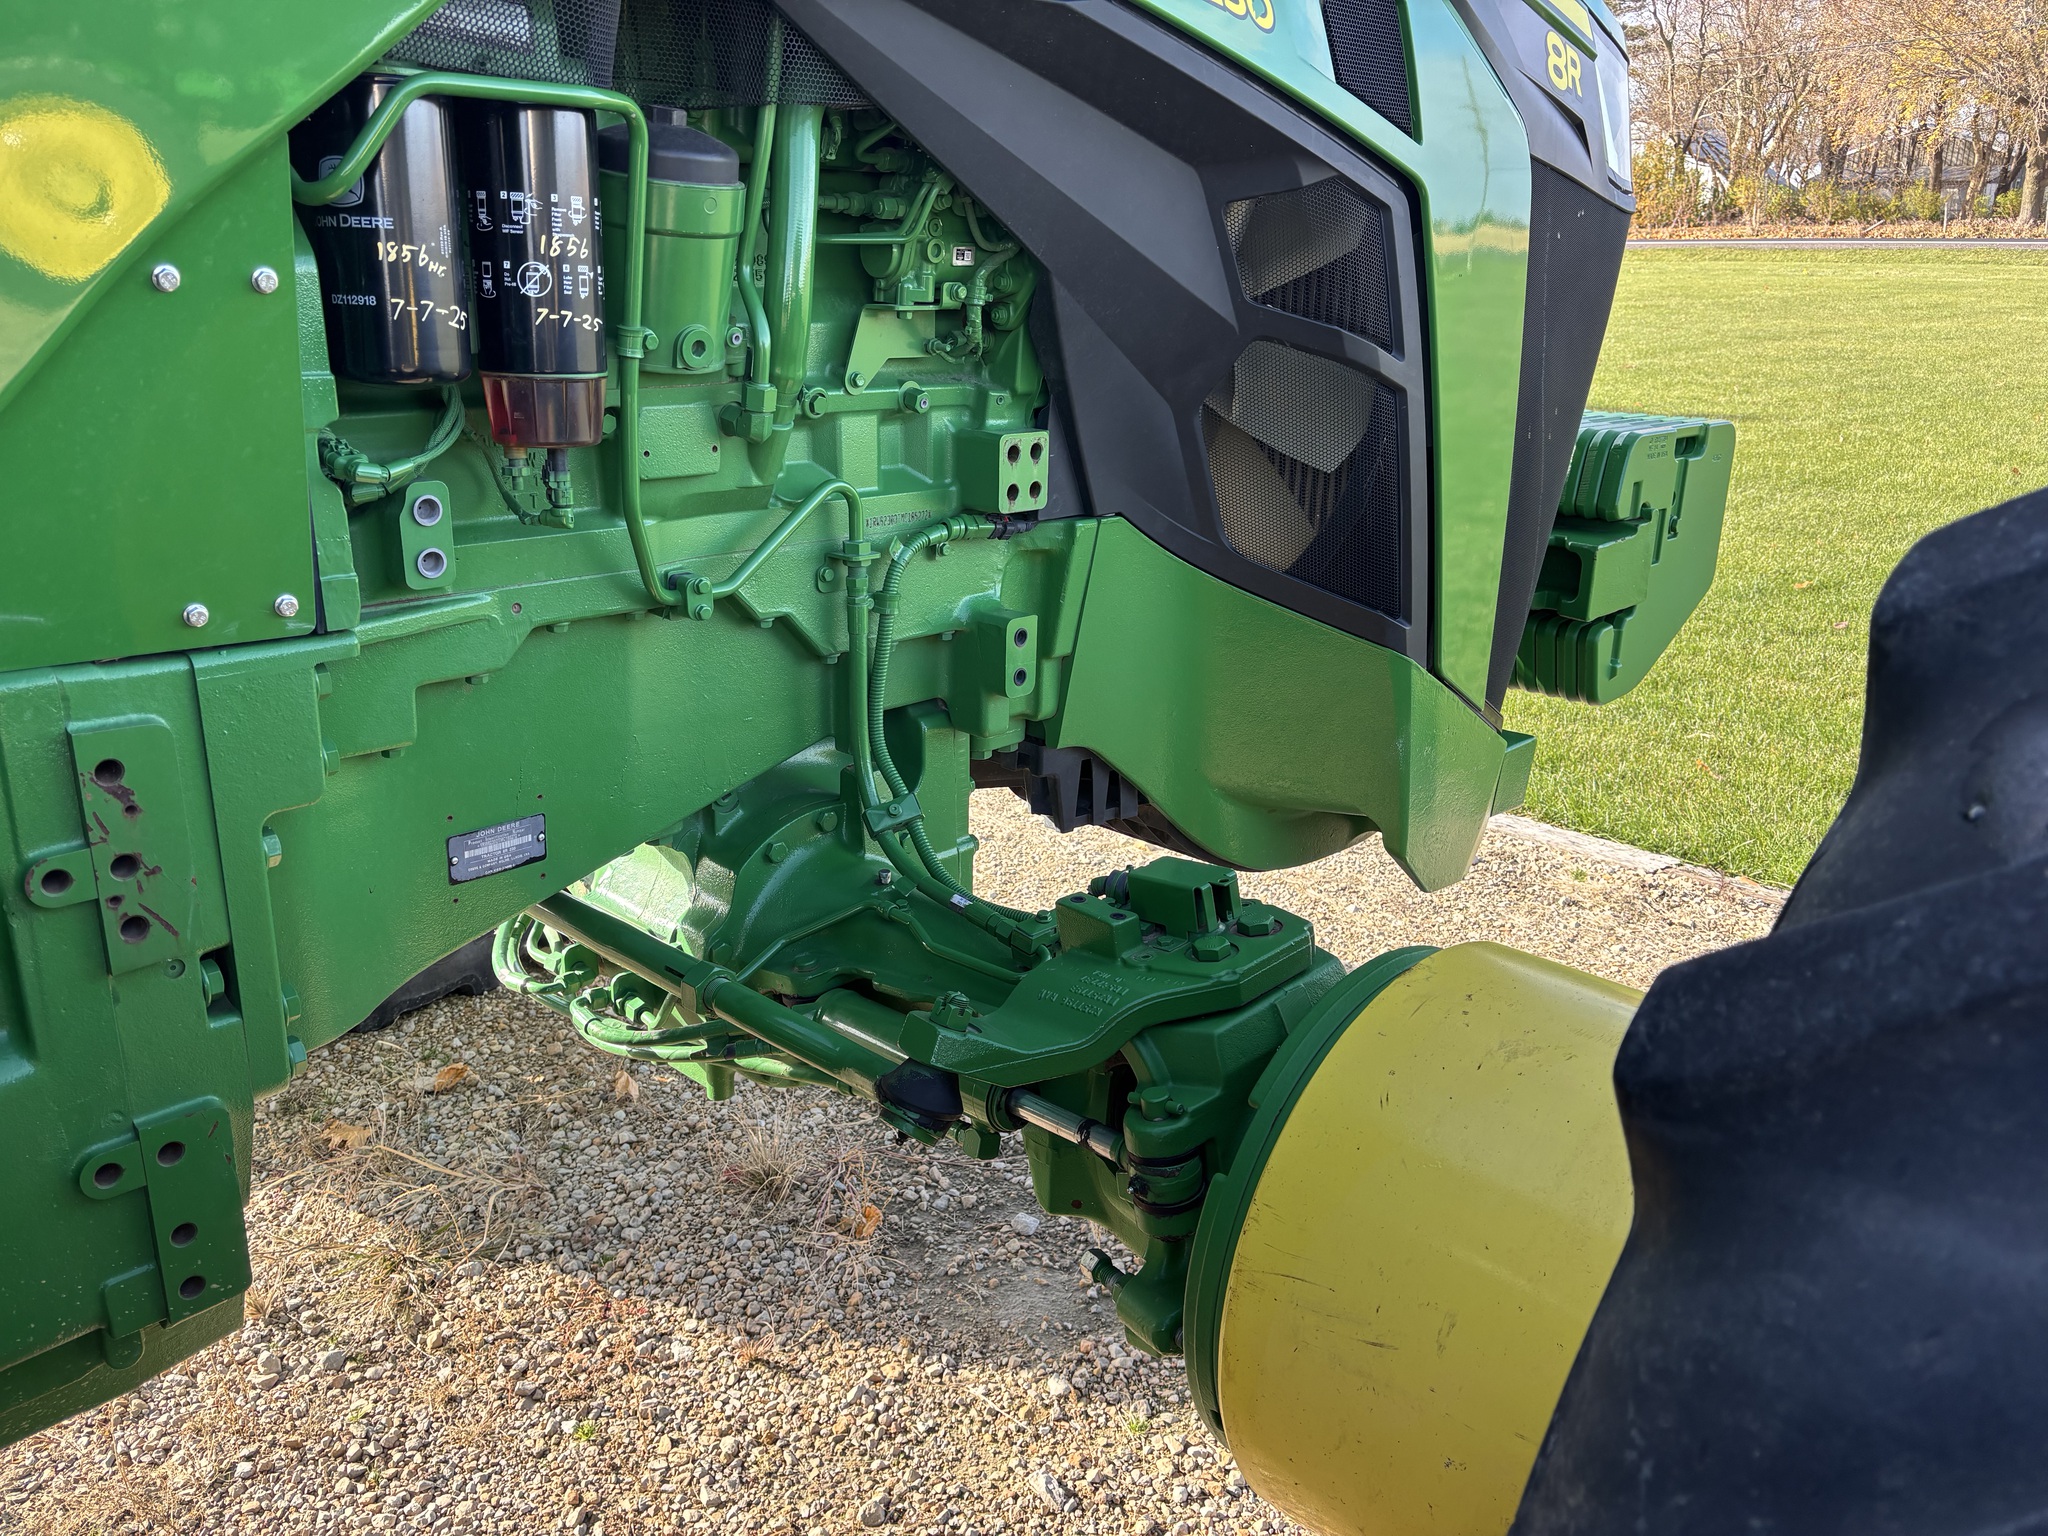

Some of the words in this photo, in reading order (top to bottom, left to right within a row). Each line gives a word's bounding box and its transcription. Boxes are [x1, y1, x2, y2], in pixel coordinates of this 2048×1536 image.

[1546, 30, 1583, 98] 8R
[339, 213, 395, 229] DEERE
[377, 241, 429, 267] 1856
[540, 235, 588, 259] 1856
[331, 293, 377, 306] DZ112918
[390, 298, 468, 331] 7-7-25
[535, 308, 603, 332] 7-7-25
[476, 828, 495, 838] JOHN
[497, 821, 520, 832] DEERE
